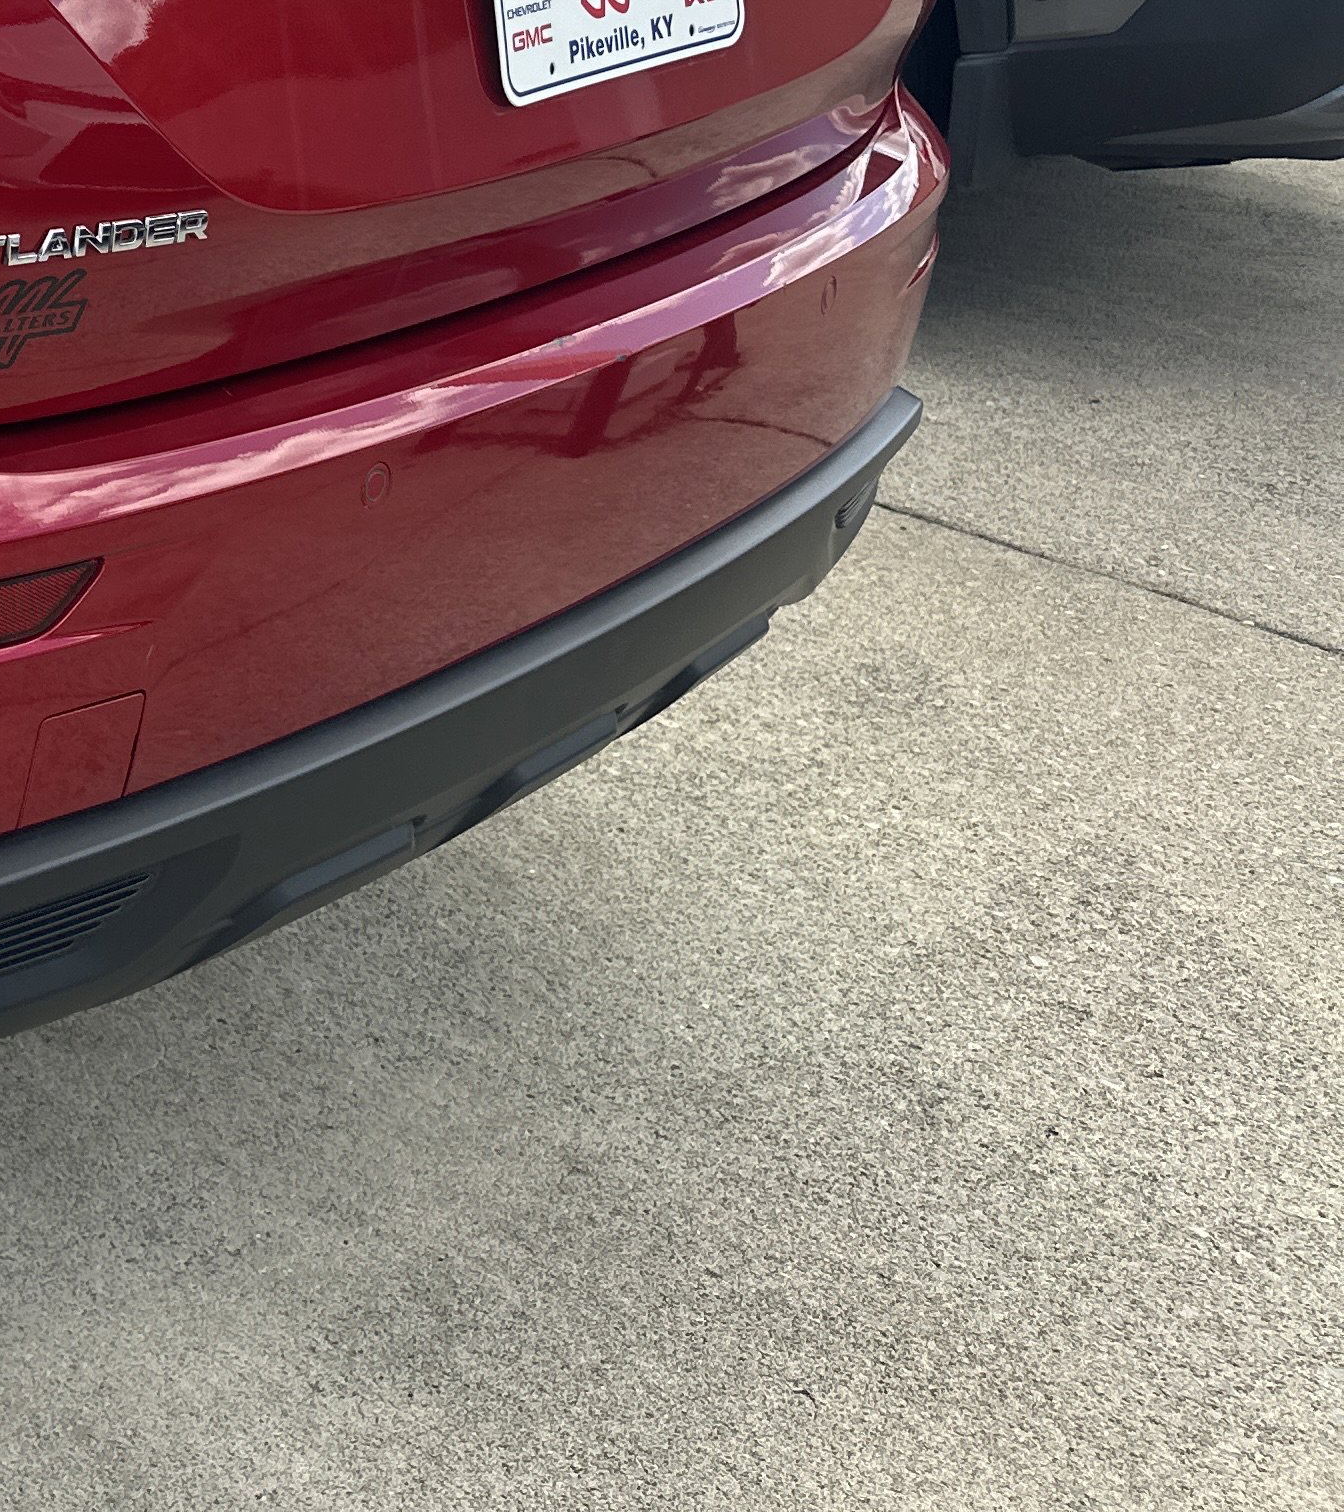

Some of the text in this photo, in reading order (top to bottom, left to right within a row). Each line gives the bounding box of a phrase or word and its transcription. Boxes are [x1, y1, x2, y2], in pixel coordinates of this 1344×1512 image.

[512, 23, 553, 53] GMC
[568, 26, 646, 64] Pikeville,
[650, 14, 674, 41] KY
